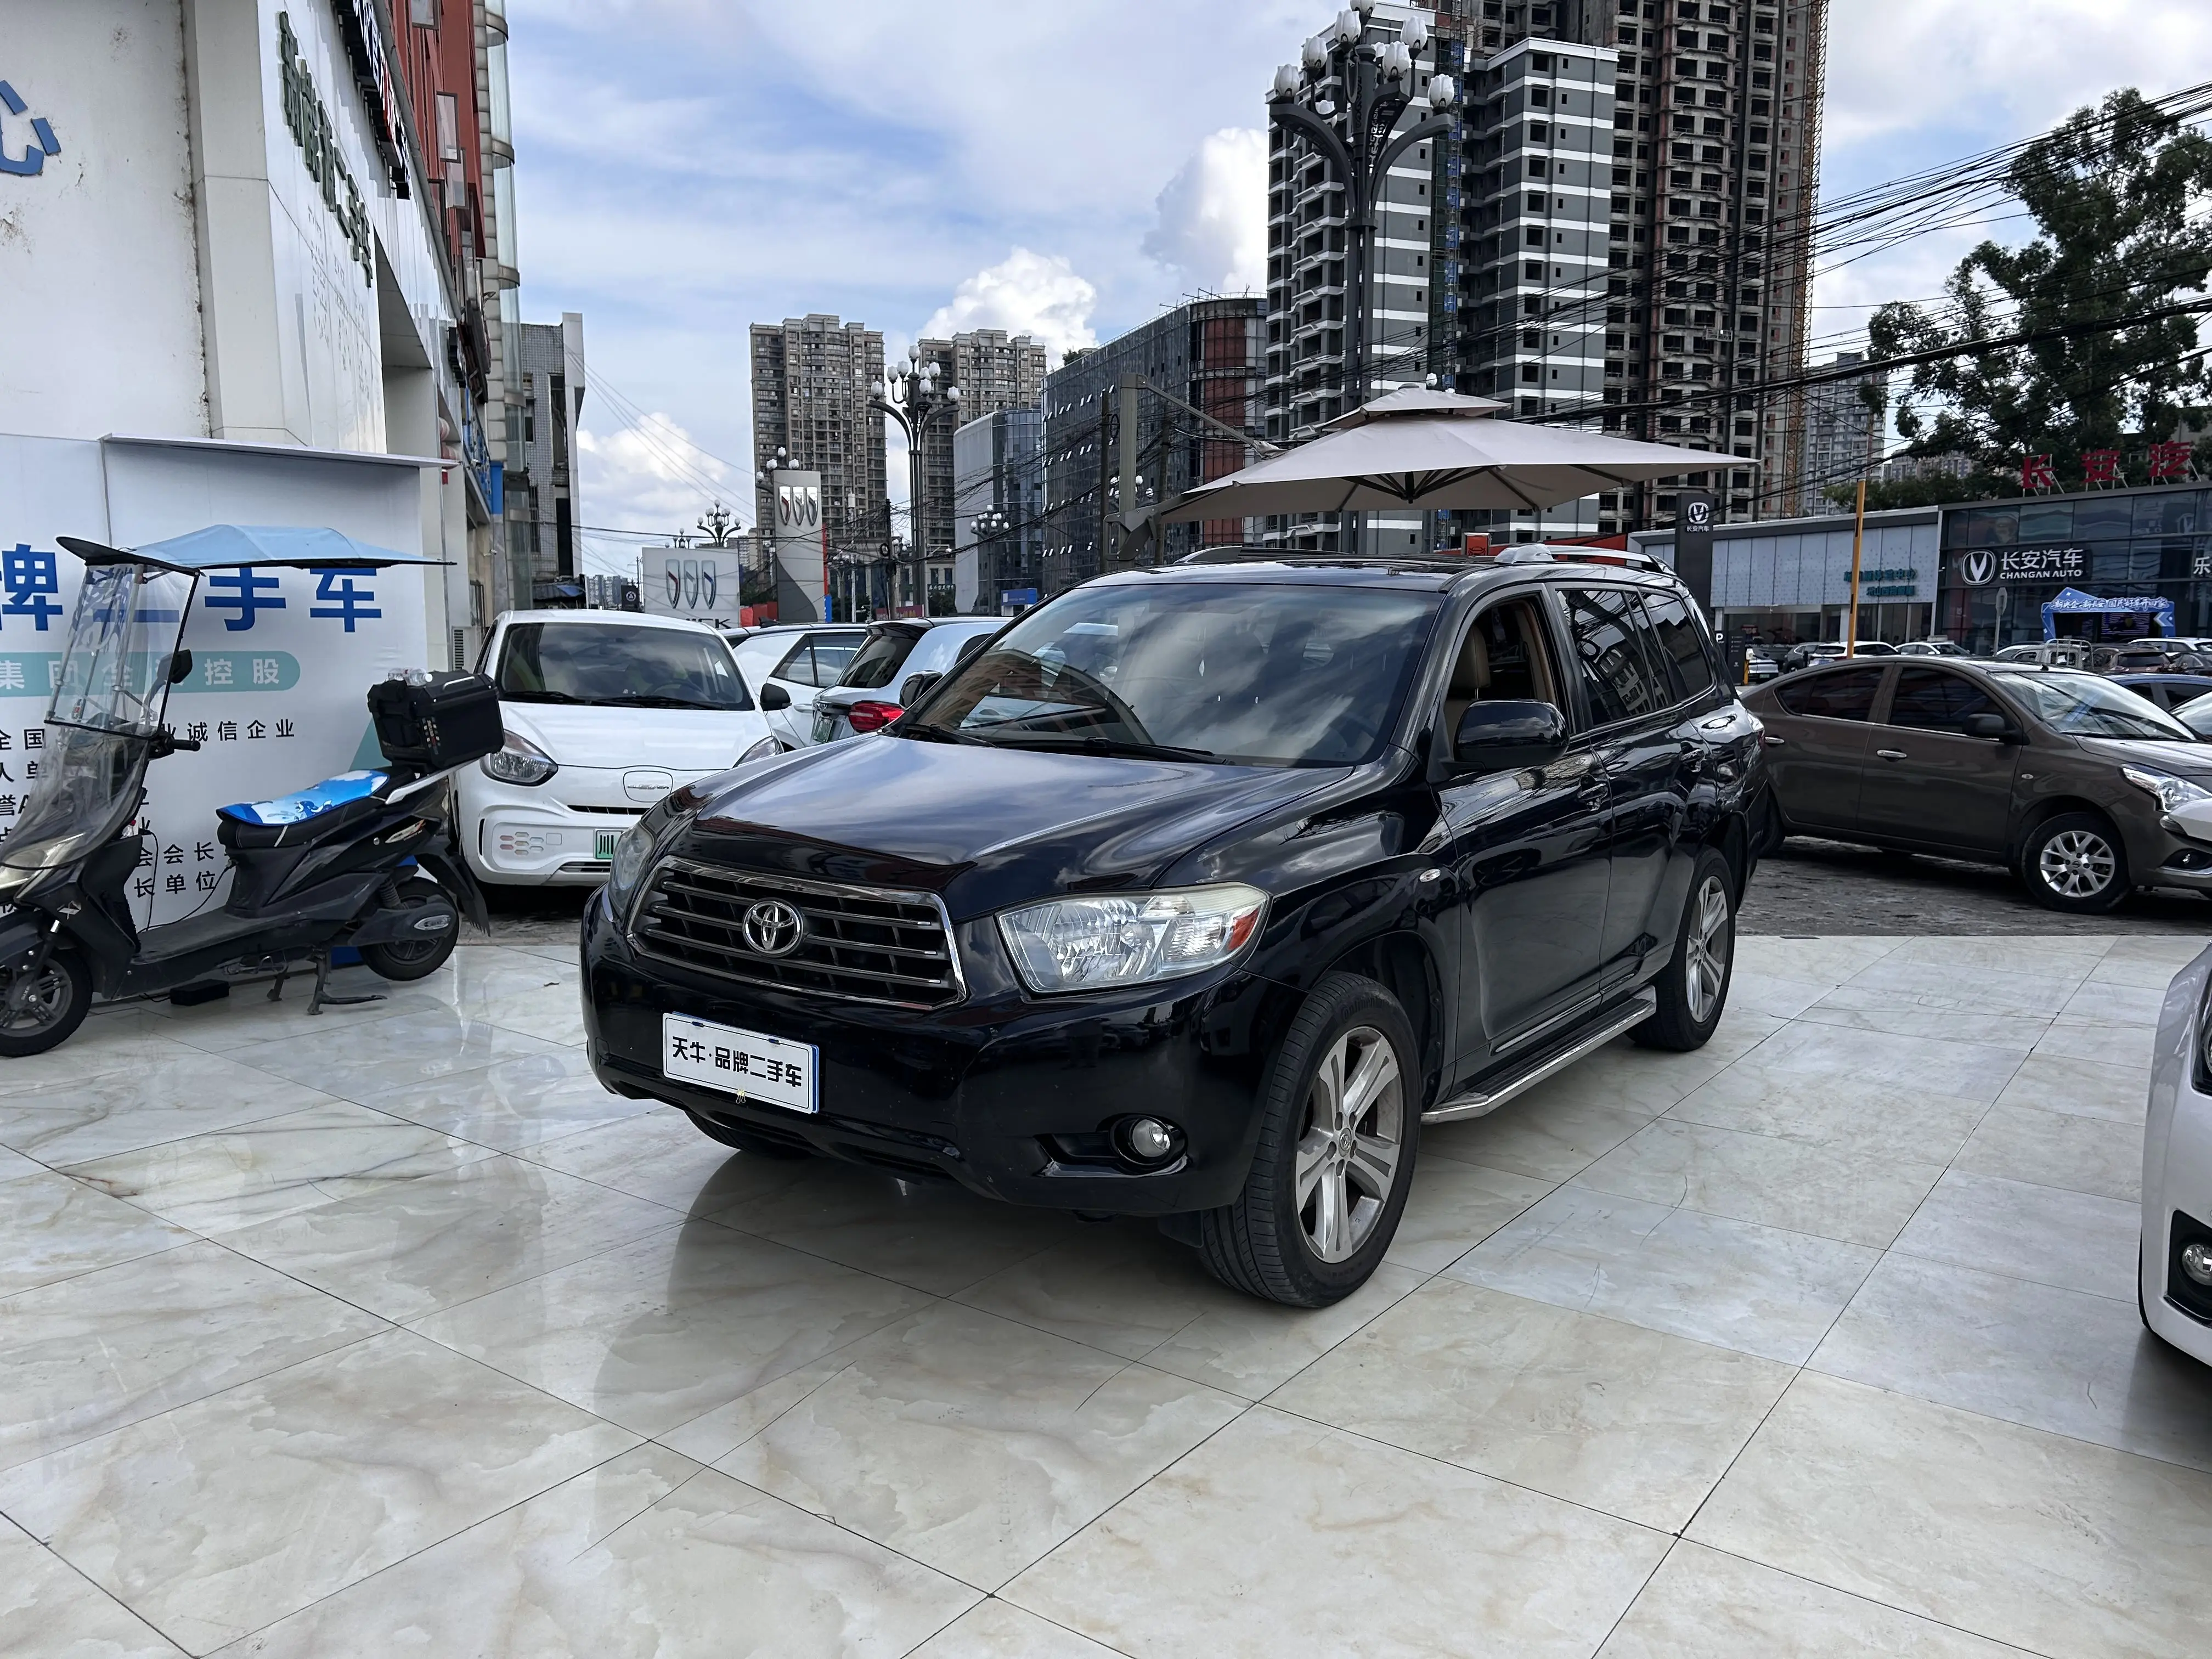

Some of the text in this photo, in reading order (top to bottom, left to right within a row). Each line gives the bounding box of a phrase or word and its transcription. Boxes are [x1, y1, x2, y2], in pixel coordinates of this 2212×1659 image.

[2023, 440, 2192, 489] 长安汽
[2000, 548, 2084, 571] 长安汽车
[2000, 569, 2083, 580] CHANGAN AUTO
[0, 658, 280, 690] 集团全控股
